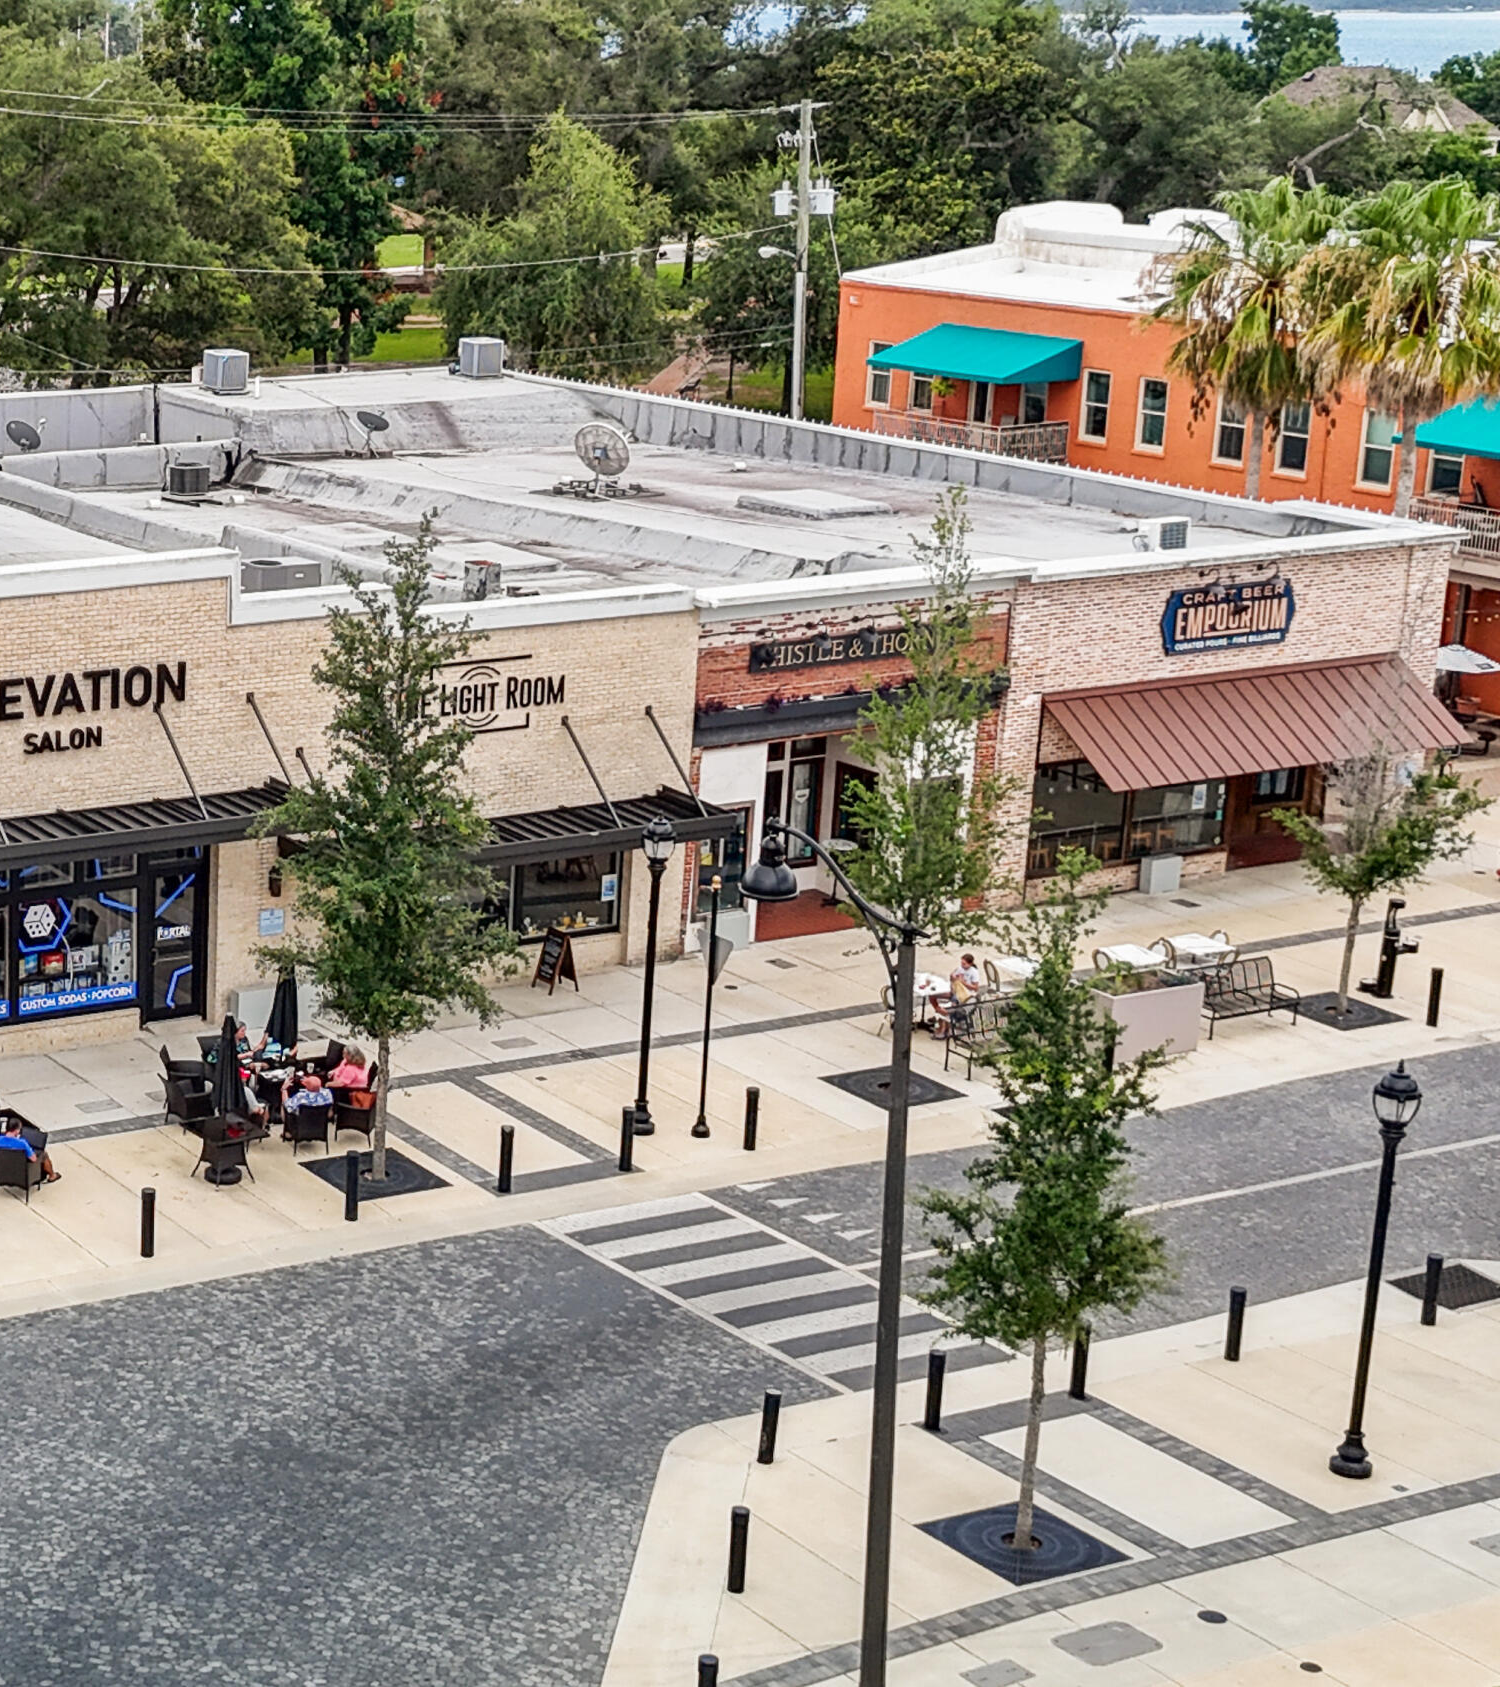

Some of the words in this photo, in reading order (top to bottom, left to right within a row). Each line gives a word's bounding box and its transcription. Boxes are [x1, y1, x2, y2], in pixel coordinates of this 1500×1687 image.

[1242, 583, 1285, 599] BEER
[759, 640, 845, 669] HISTLE
[848, 638, 864, 658] &
[440, 682, 499, 717] LIGHT
[506, 674, 565, 709] ROOM
[24, 726, 102, 755] SALON
[21, 997, 56, 1010] CUSTOM
[58, 992, 87, 1005] SODAS
[92, 985, 133, 1000] POPCORN
